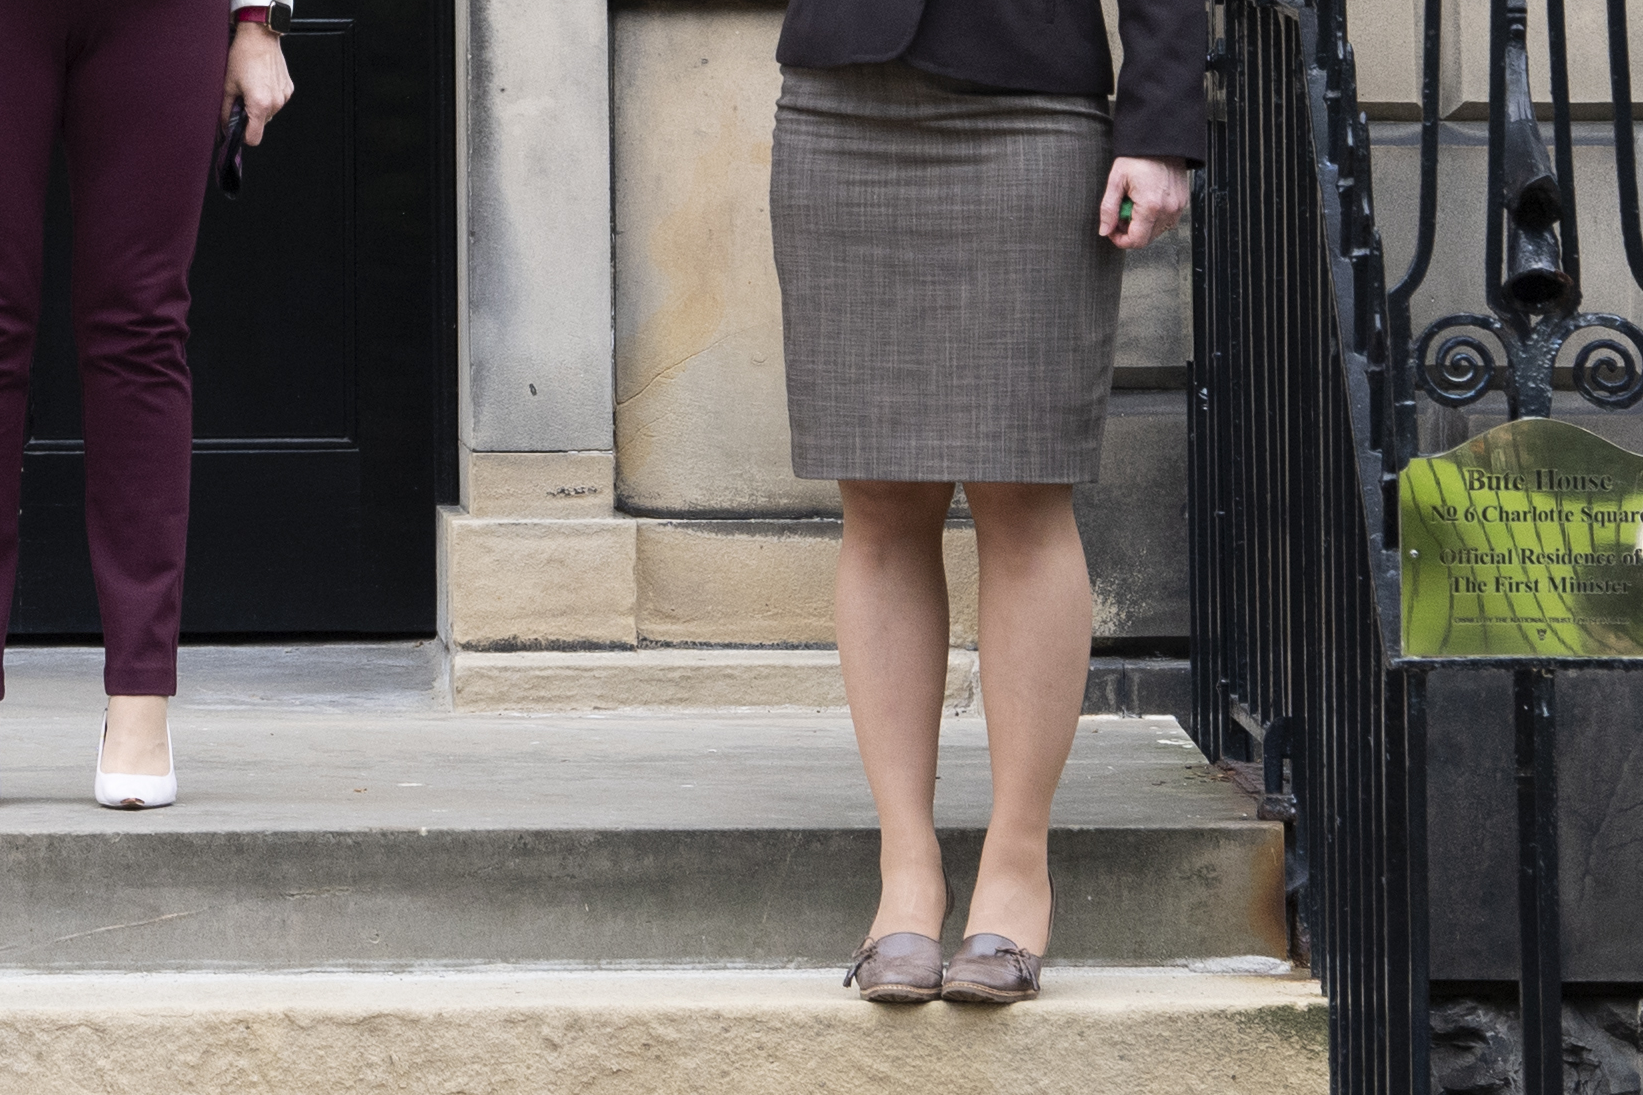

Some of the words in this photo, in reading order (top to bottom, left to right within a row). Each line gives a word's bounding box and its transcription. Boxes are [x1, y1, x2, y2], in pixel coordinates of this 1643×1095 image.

[1466, 469, 1525, 491] Bute
[1535, 469, 1613, 491] House
[1464, 506, 1475, 523] 6
[1482, 506, 1574, 523] Charlotte
[1439, 548, 1513, 565] Official
[1520, 548, 1616, 565] Residence
[1623, 548, 1643, 565] of
[1452, 576, 1487, 593] The
[1494, 576, 1540, 593] First
[1548, 576, 1631, 593] Minister
